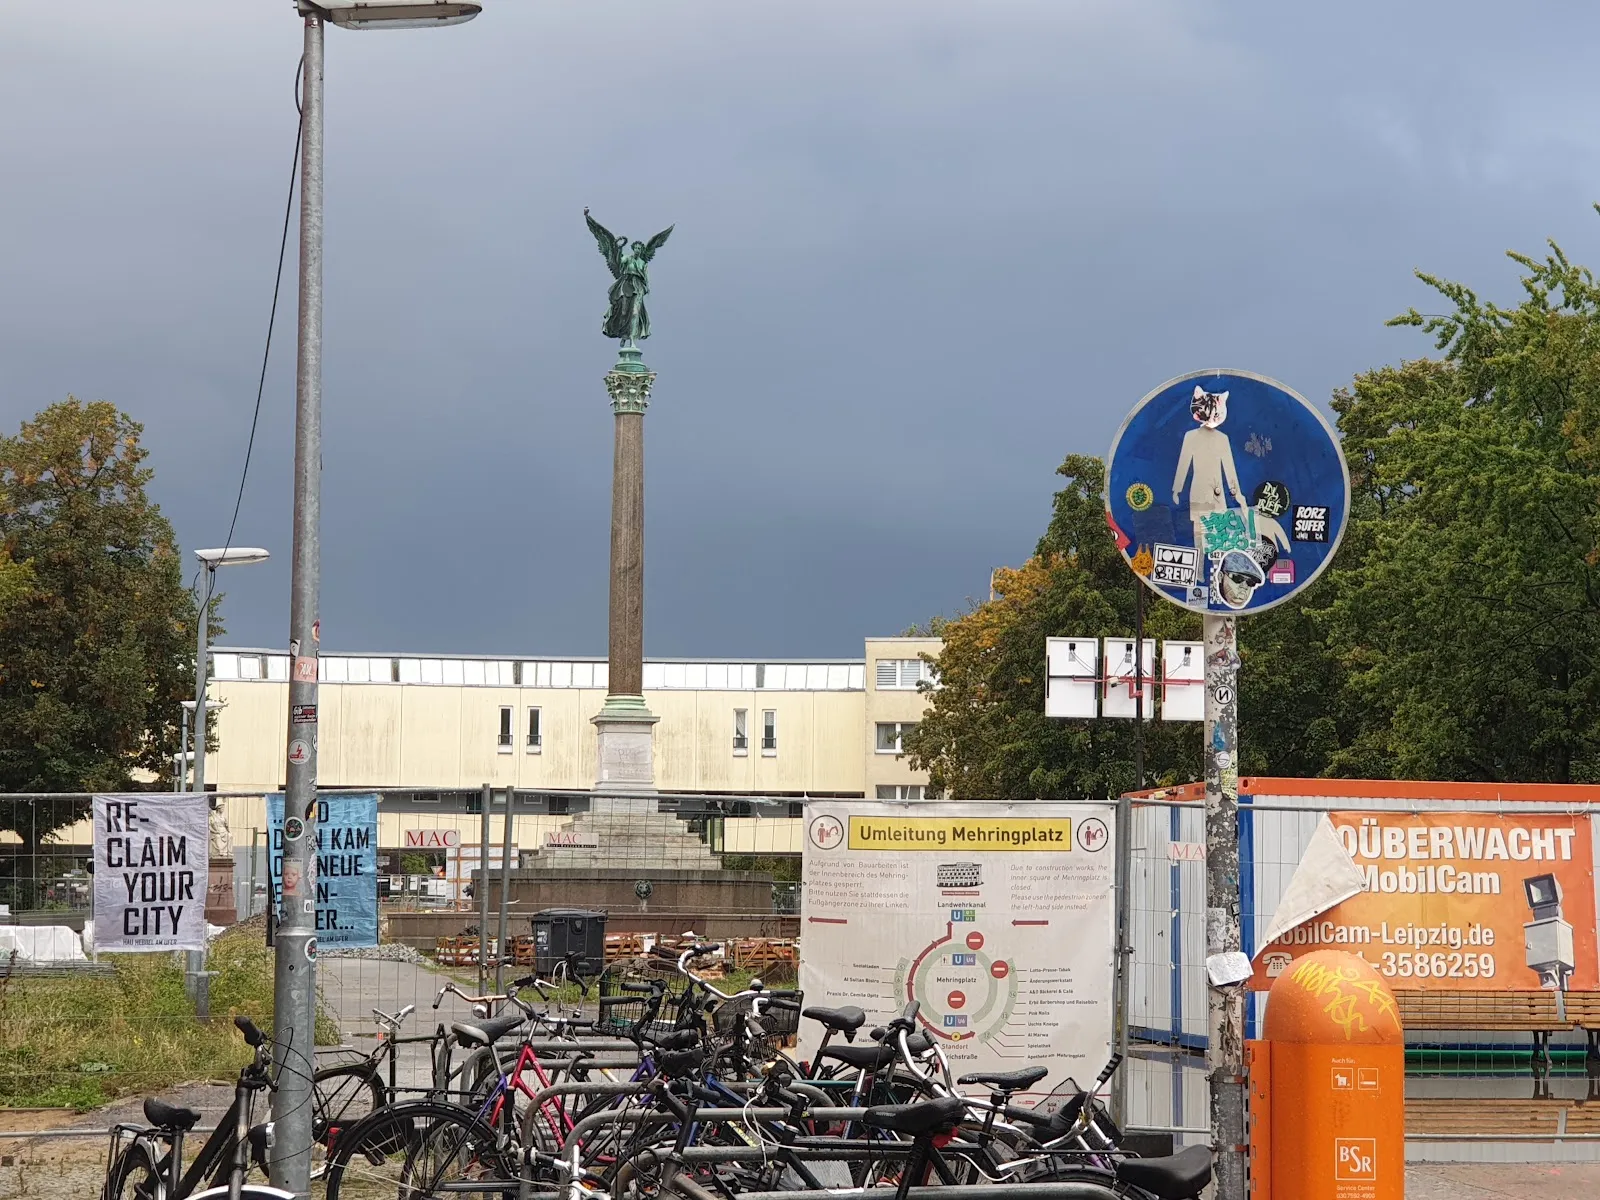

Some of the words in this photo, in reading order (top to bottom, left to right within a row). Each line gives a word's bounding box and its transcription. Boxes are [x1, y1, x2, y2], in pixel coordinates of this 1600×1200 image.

[1296, 506, 1326, 519] RORZ
[1295, 520, 1326, 531] SUFER
[106, 802, 149, 832] RE-
[332, 828, 369, 850] KAM
[407, 831, 457, 847] MAC
[860, 826, 946, 844] Umleitung
[952, 827, 1063, 845] Mehringplatz
[1337, 818, 1576, 861] OÜBERWACHT
[107, 836, 186, 868] CLAIM
[1173, 844, 1204, 859] MA
[317, 855, 363, 876] NEUE
[810, 860, 839, 868] Aufgrund
[123, 871, 194, 903] YOUR
[1355, 864, 1500, 894] MobilCam
[809, 899, 858, 908] Fußgängerzone
[124, 906, 183, 936] CITY
[954, 911, 960, 920] U
[1270, 921, 1495, 949] obilCam-Leipzig.de
[955, 956, 961, 964] U
[1356, 951, 1495, 978] -3586259
[946, 1017, 953, 1025] U
[1340, 1146, 1372, 1172] BSR
